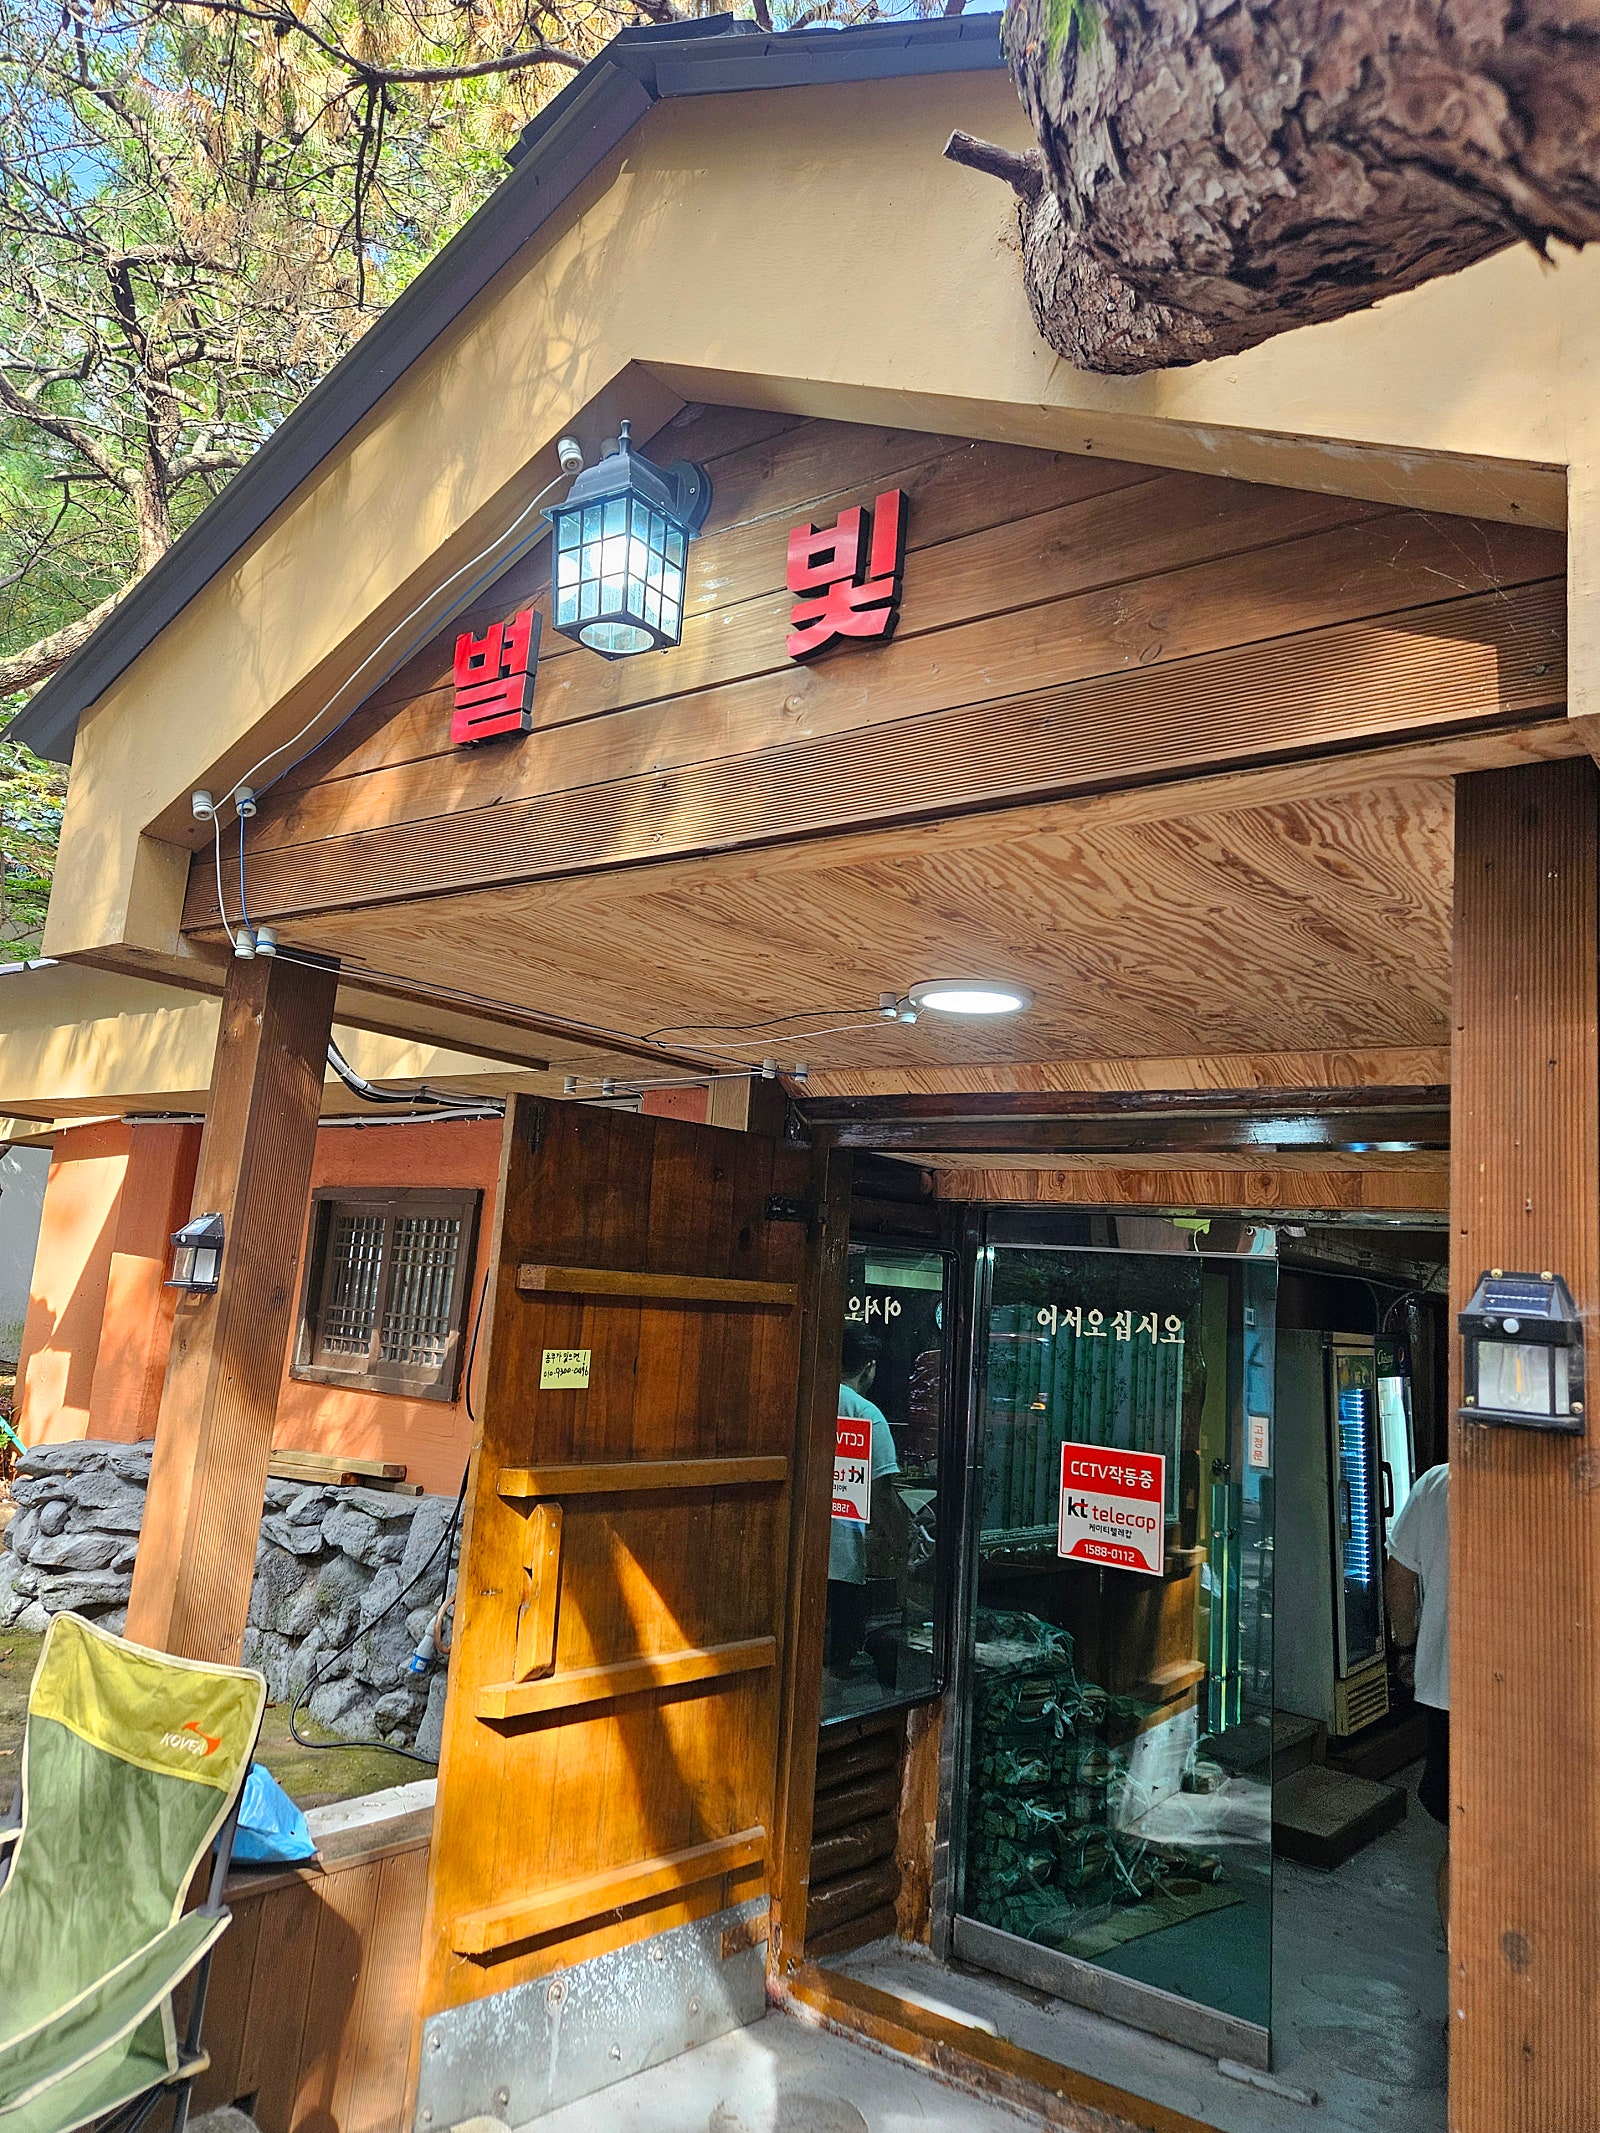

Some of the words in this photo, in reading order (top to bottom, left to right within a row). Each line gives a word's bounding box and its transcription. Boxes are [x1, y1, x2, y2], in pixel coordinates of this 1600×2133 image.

[450, 607, 537, 745] 별
[786, 488, 901, 659] 빛
[1070, 1460, 1155, 1490] CCTV작동중
[1067, 1496, 1089, 1519] kt
[1091, 1505, 1157, 1534] telecop
[1083, 1543, 1136, 1563] 1588-0112
[159, 1732, 206, 1756] KOVEA
